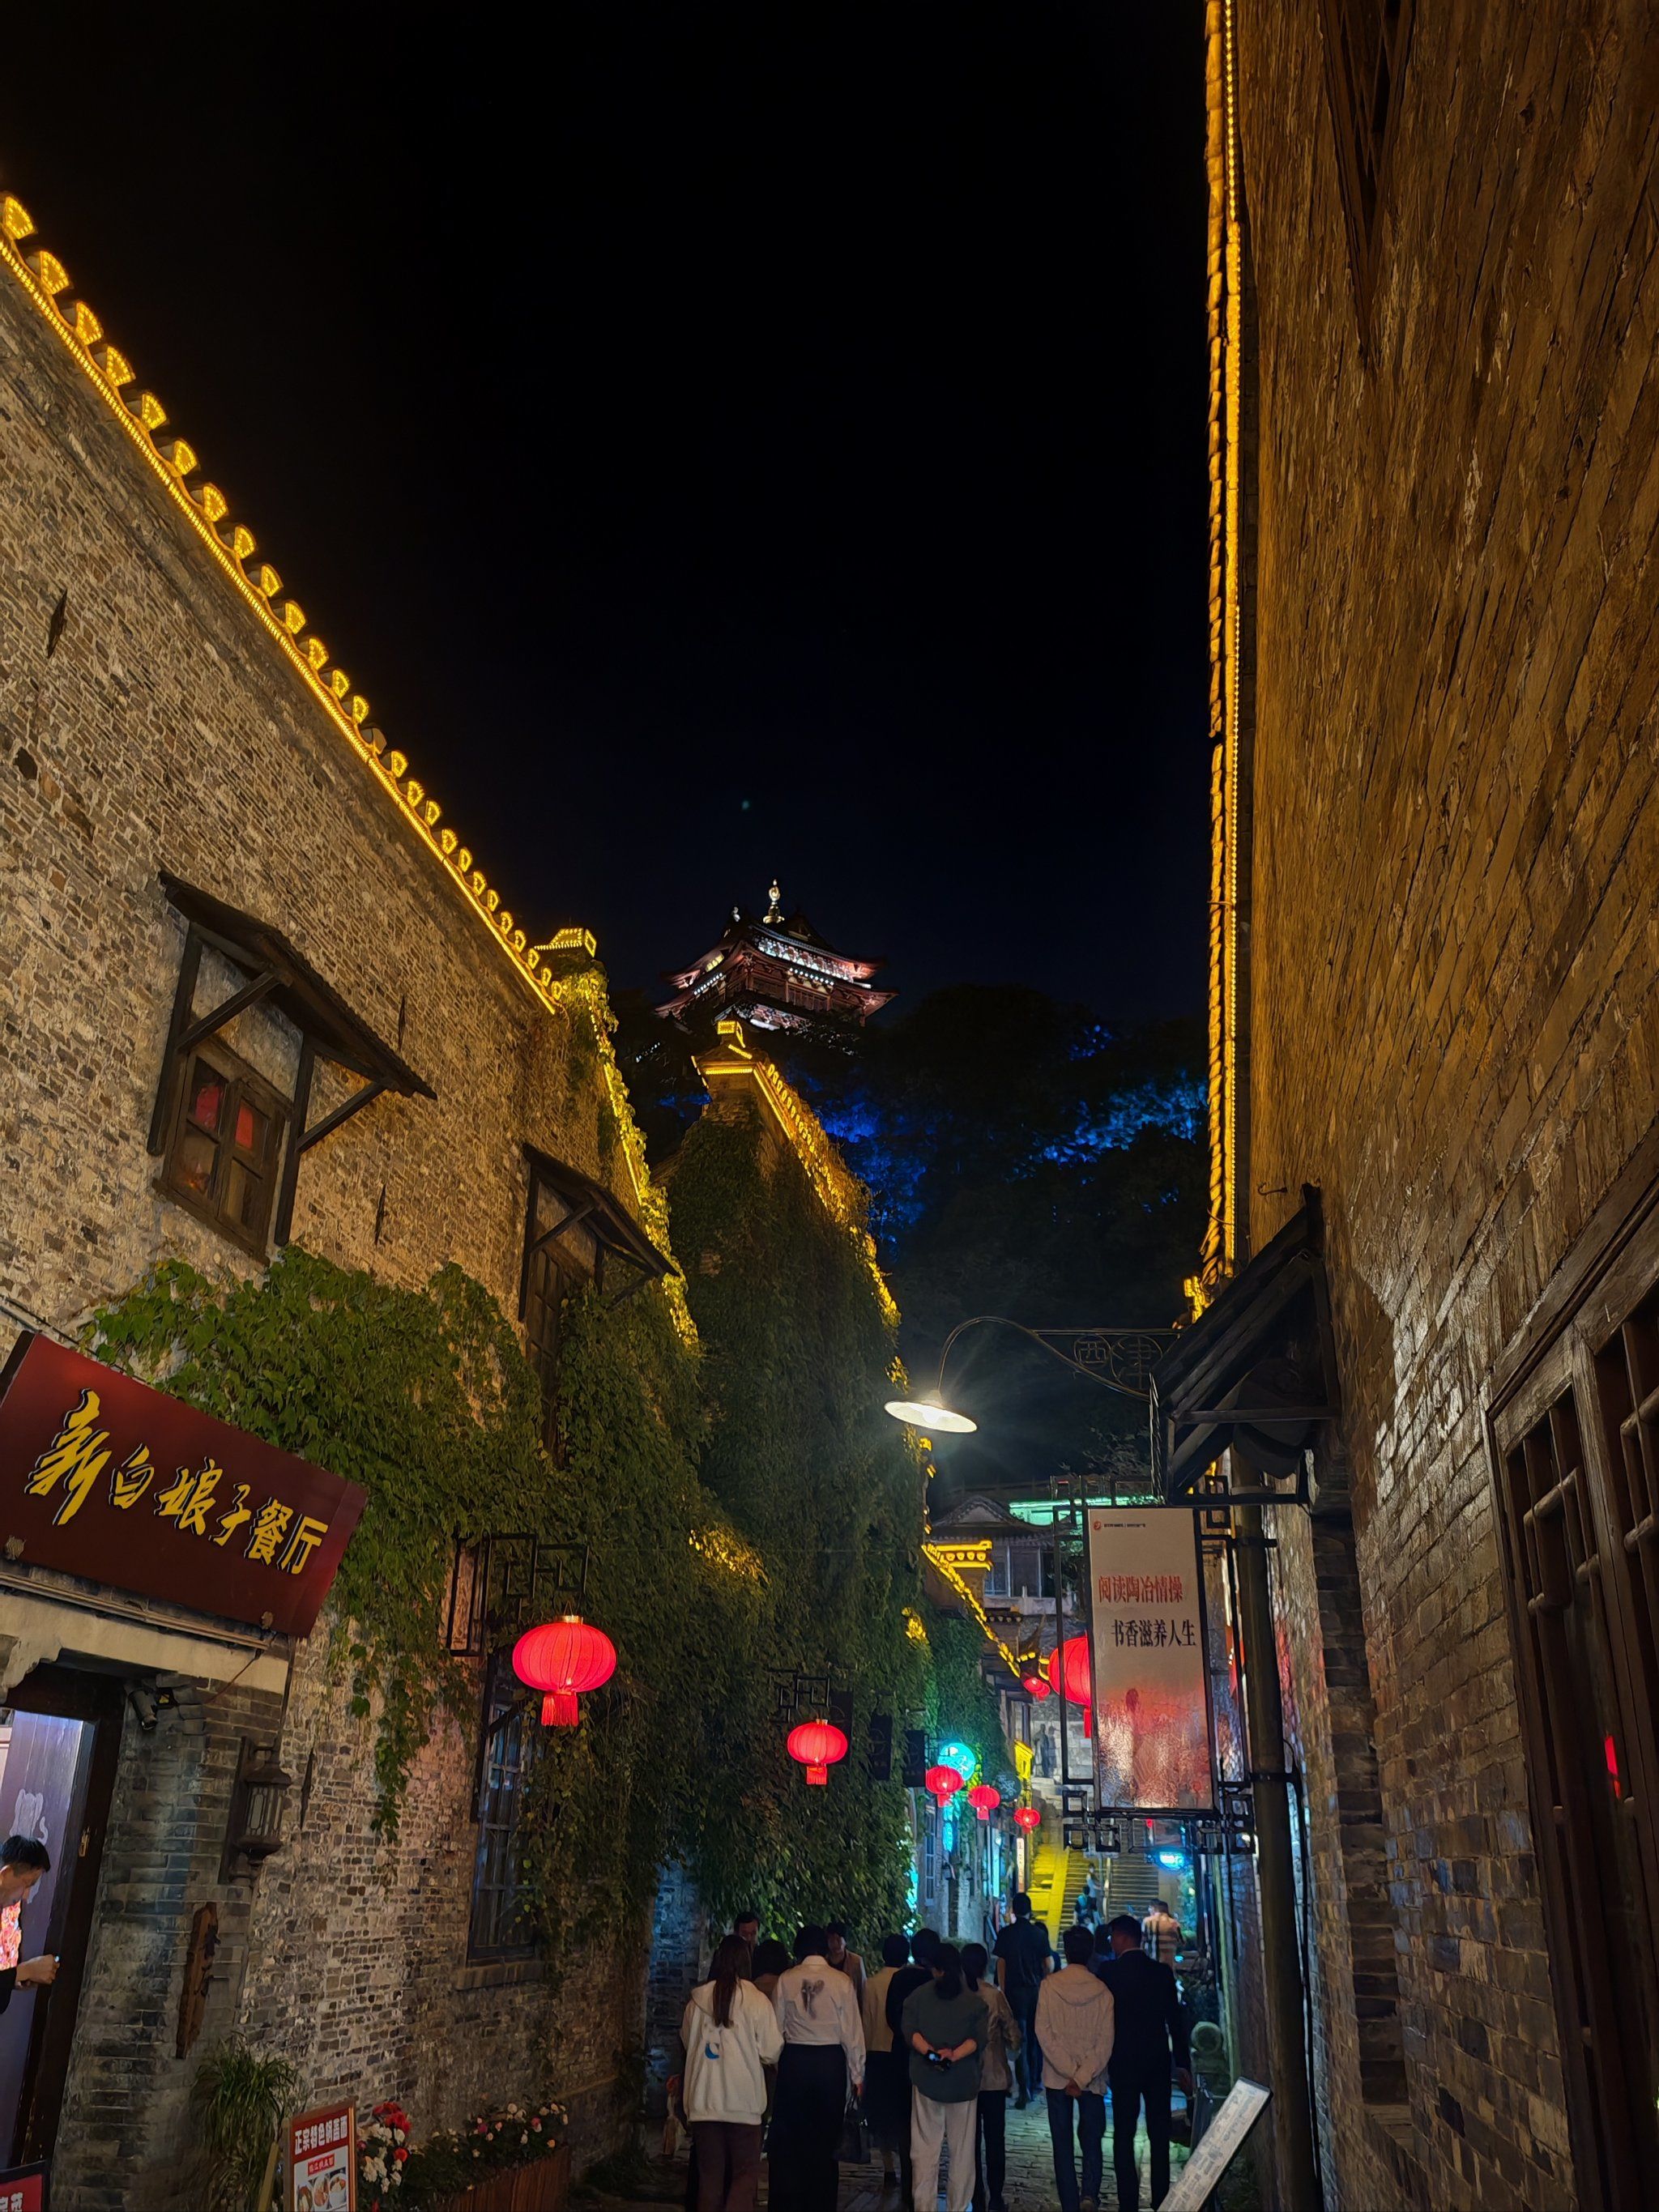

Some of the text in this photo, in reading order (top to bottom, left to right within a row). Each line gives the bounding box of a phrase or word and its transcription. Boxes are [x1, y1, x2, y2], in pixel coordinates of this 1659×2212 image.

[25, 1388, 328, 1575] 新白娘子餐厅
[1098, 1575, 1183, 1603] 阅读陶冶情操
[1111, 1619, 1196, 1647] 书香滋养人生
